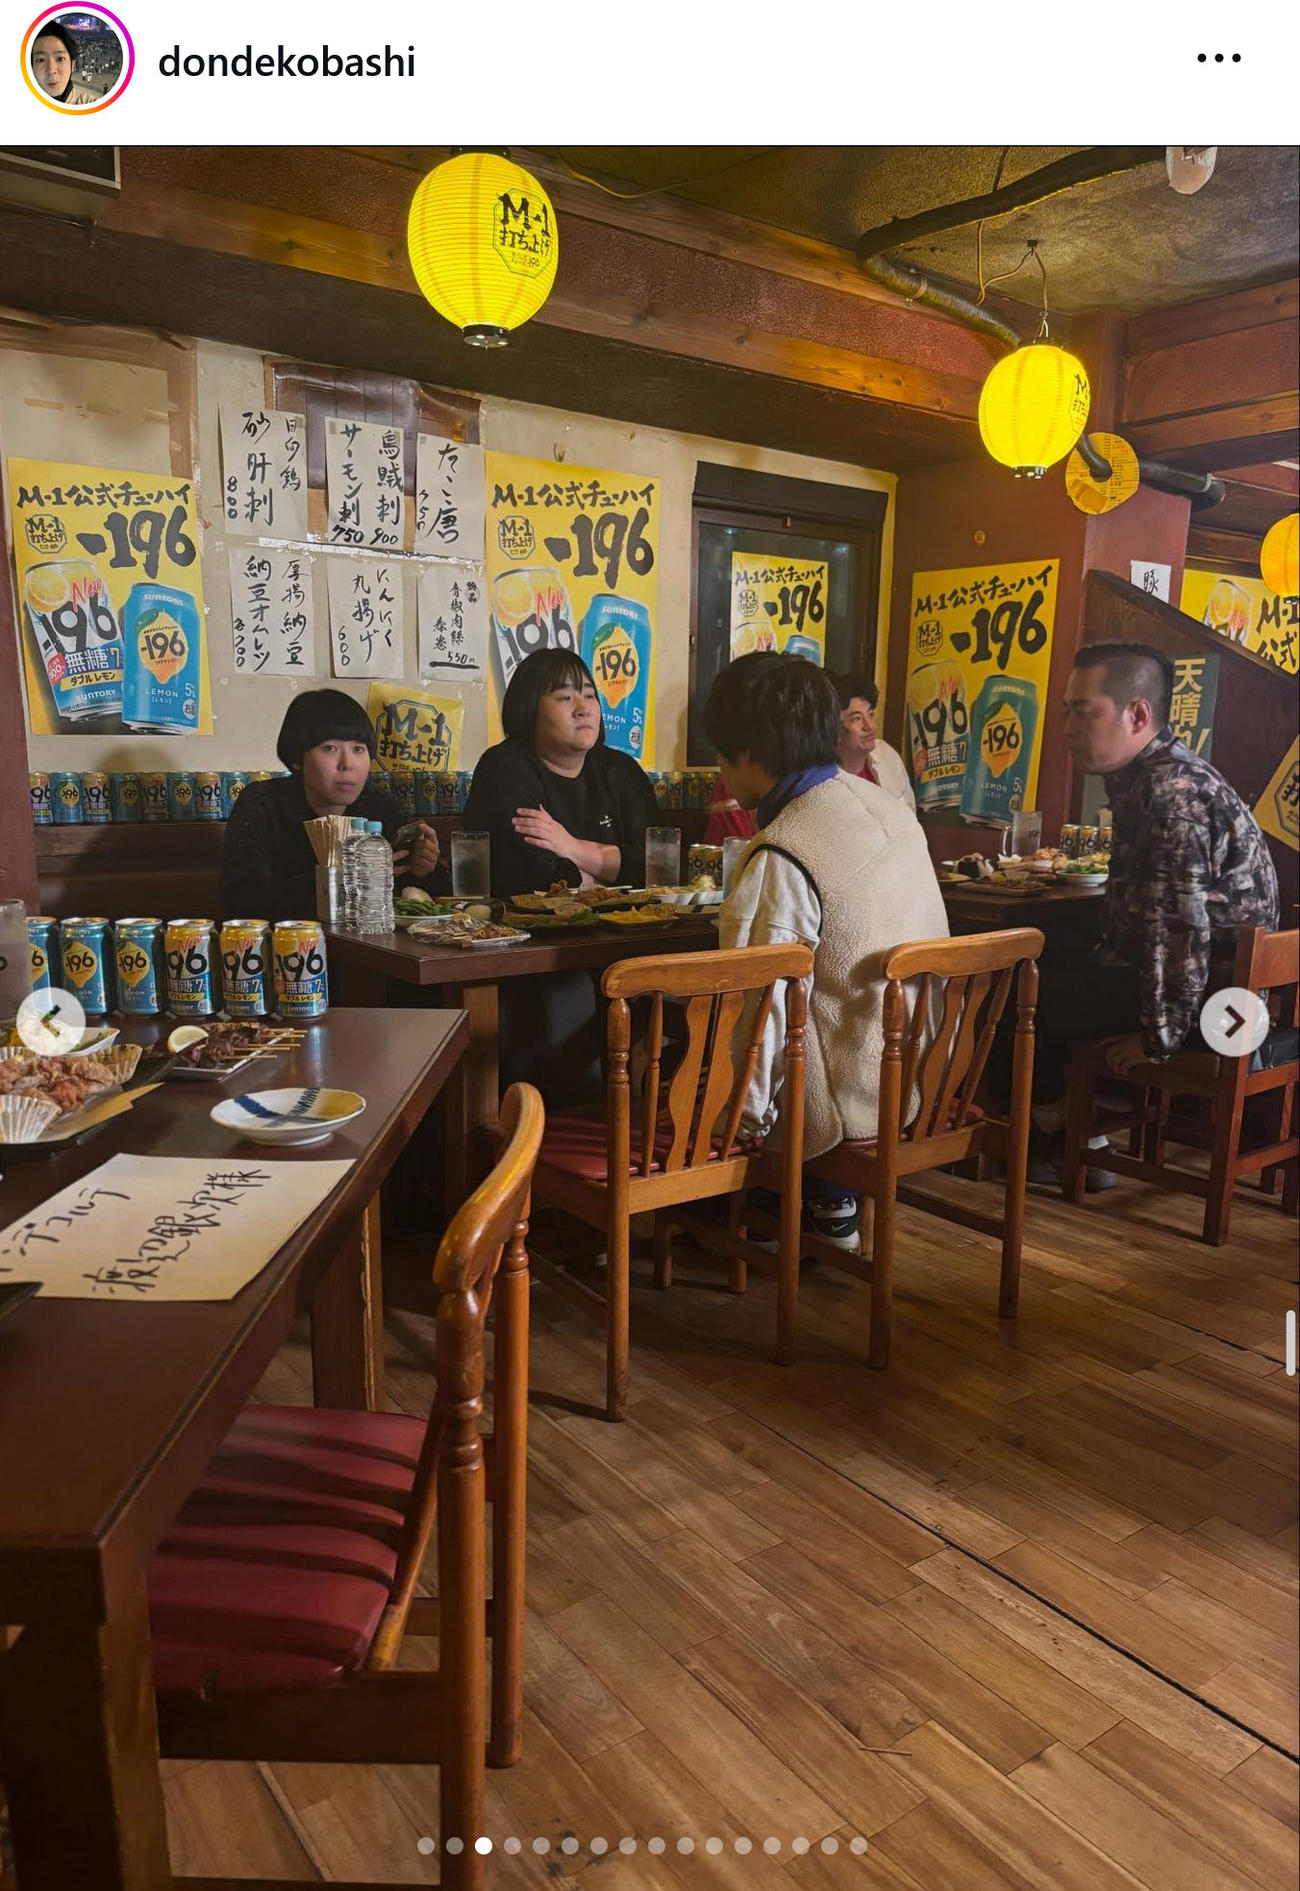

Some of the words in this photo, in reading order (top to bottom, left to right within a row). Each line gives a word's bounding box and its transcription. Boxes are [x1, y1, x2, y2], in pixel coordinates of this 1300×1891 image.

[496, 192, 551, 238] M-1
[241, 411, 273, 526] 砂肝刺
[338, 423, 363, 526] サーモン刺
[17, 481, 191, 508] M-1公式チューハイ
[227, 476, 238, 519] 800
[491, 480, 654, 510] M-1公式チューハイ
[25, 516, 63, 533] M-1
[76, 505, 196, 579] -196
[330, 524, 364, 543] 750
[369, 527, 399, 545] 900
[499, 518, 533, 536] M-1
[544, 507, 654, 589] -196
[71, 577, 101, 613] New
[143, 593, 184, 606] SUNTORY
[243, 555, 271, 672] 納豆オムレツ
[281, 559, 309, 665] 厚揚納豆
[377, 569, 394, 647] にんにく
[763, 580, 824, 632] -196
[352, 574, 379, 663] 丸揚げ
[950, 590, 1048, 671] -196
[65, 649, 109, 674] 無糖
[141, 630, 185, 660] -196
[338, 625, 350, 666] 600
[595, 648, 636, 680] -196
[145, 688, 178, 698] LEMON
[382, 702, 449, 747] M-1
[602, 713, 626, 724] EMON
[983, 722, 1019, 753] -196
[380, 735, 447, 767] 打ち上げ
[0, 1187, 131, 1272] ンデコルテ
